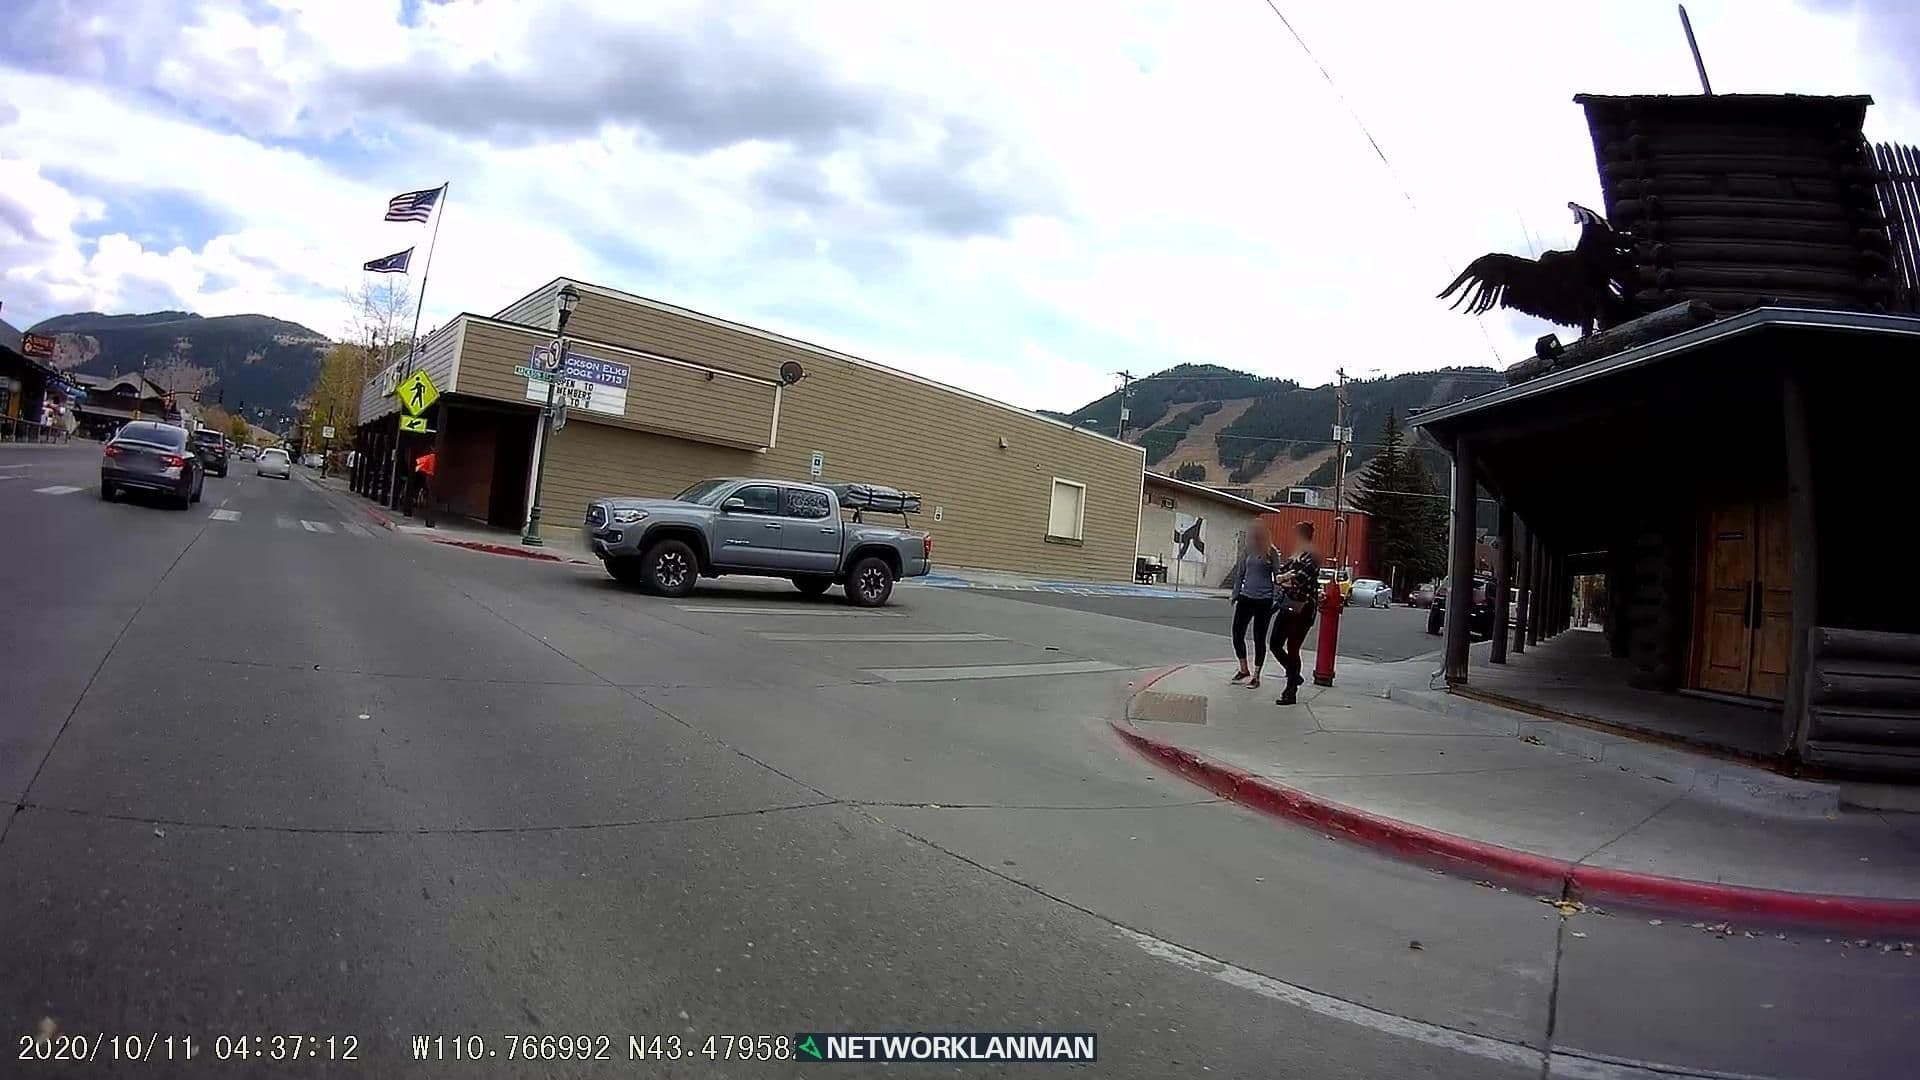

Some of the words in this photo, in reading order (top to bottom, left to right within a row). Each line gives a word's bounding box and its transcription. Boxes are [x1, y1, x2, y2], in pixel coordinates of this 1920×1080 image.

[564, 358, 600, 371] CKSON
[602, 364, 628, 376] ELKS
[584, 382, 594, 392] TO
[556, 386, 593, 401] MEMBERS
[571, 398, 580, 407] TO
